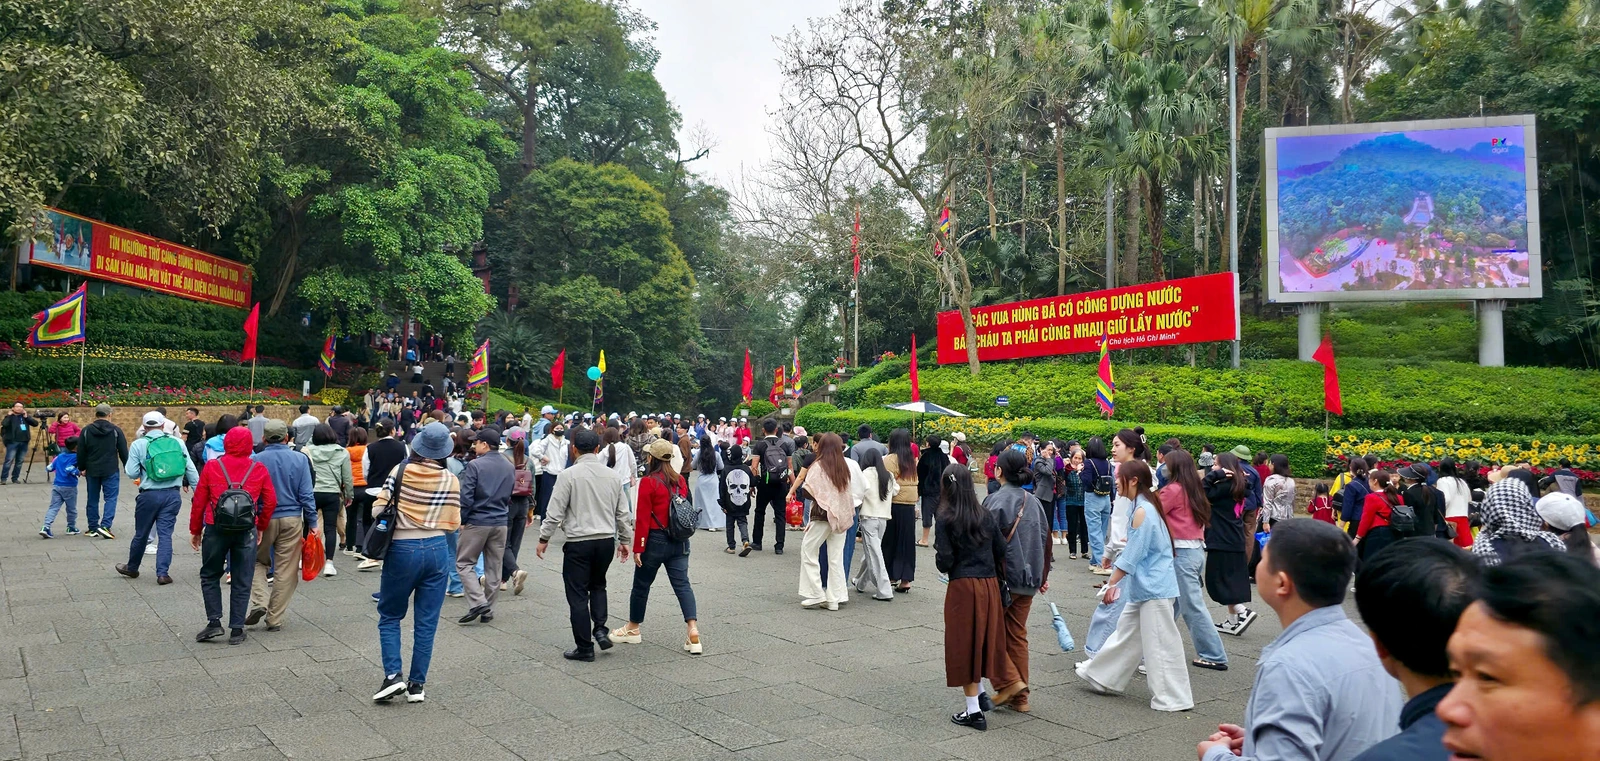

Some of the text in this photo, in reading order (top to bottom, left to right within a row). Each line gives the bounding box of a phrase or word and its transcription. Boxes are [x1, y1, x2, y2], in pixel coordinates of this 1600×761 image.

[109, 233, 120, 251] TÍN
[121, 238, 147, 258] NGƯỠNG
[148, 244, 161, 261] THỜ
[161, 248, 177, 266] CÚNG
[96, 254, 104, 270] DI
[105, 252, 120, 274] SẢN
[120, 260, 134, 277] VĂN
[134, 263, 148, 281] HÓA
[148, 268, 160, 284] PHI
[160, 269, 171, 288] VẬT
[172, 270, 183, 289] THỂ
[193, 278, 207, 296] DIỆN
[207, 279, 219, 297] CỦA
[991, 310, 1009, 326] VUA
[1011, 305, 1039, 323] HÙNG
[1041, 301, 1056, 320] ĐÃ
[1058, 299, 1073, 318] CÓ
[1076, 296, 1107, 316] CÔNG
[1110, 292, 1144, 313] DỰNG
[1147, 285, 1182, 307] NƯỚC
[953, 333, 967, 350] BÁ
[1002, 331, 1012, 346] TA
[1014, 324, 1039, 345] PHẢI
[1041, 323, 1071, 342] CÙNG
[1073, 320, 1103, 338] NHAU
[1107, 315, 1128, 335] GIỮ
[1130, 310, 1152, 333] LẤY
[1156, 305, 1199, 331] NƯỚC”
[1109, 337, 1122, 345] Chủ
[1123, 337, 1135, 345] tịch
[1136, 334, 1146, 343] Hồ
[1147, 334, 1158, 342] Chí
